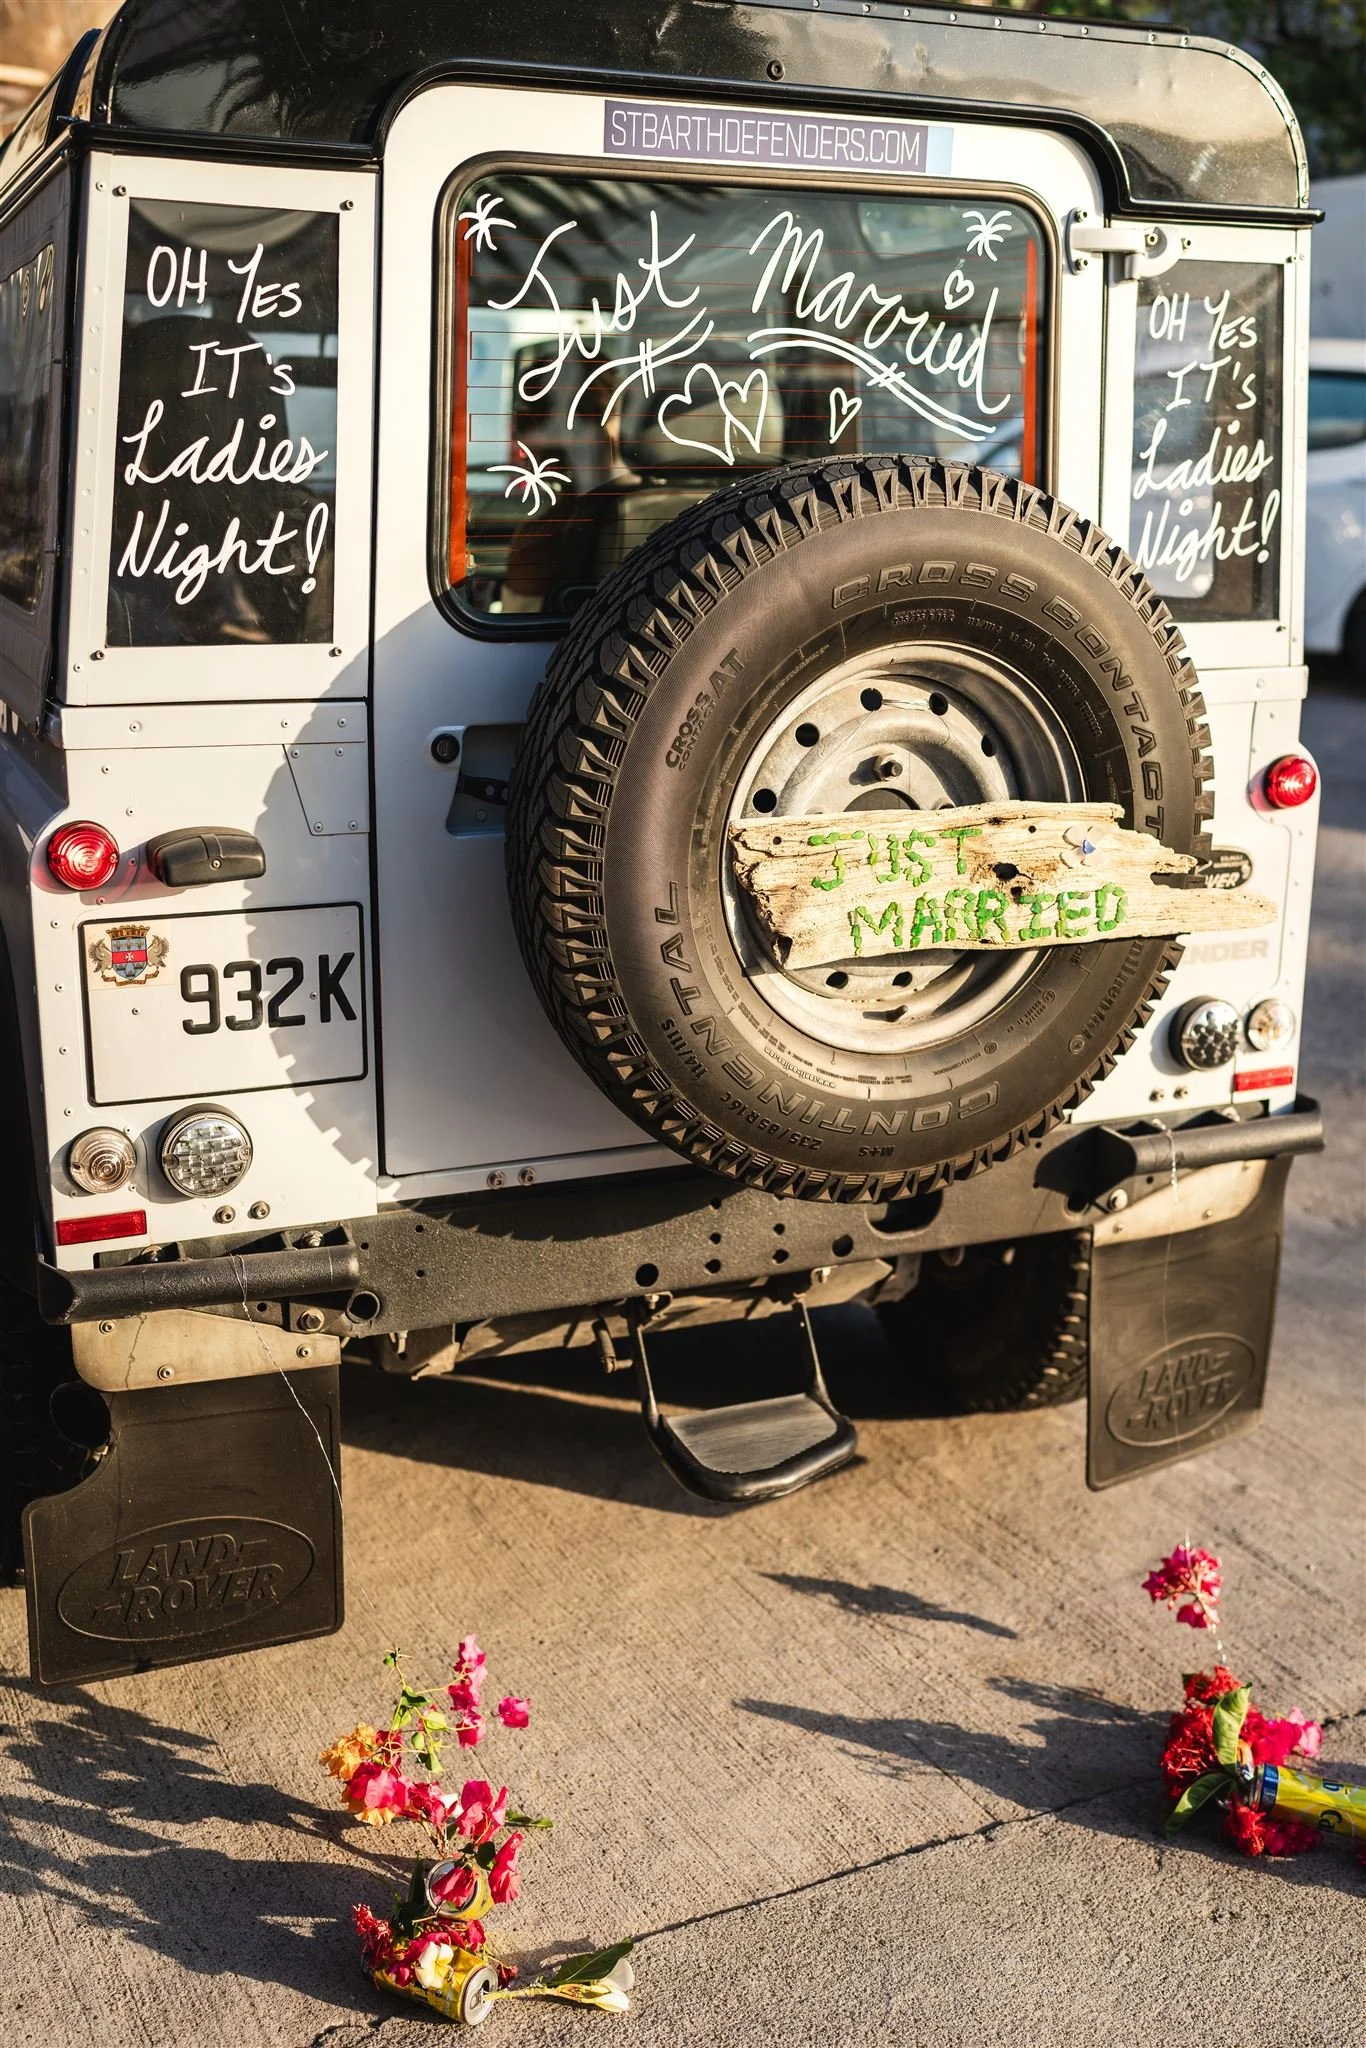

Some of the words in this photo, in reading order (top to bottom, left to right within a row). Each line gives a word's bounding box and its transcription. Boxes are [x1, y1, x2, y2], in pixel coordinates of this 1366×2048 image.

[610, 109, 922, 167] STBARTHDEFENDERS.COM
[146, 245, 208, 308] OH
[487, 210, 699, 401] Just
[748, 210, 1011, 415] Married
[1149, 291, 1190, 342] OH
[122, 399, 329, 486] Ladies
[1133, 418, 1274, 500] Ladies
[117, 499, 330, 605] Night!
[1134, 488, 1281, 582] Night!
[709, 648, 745, 699] AT
[832, 561, 1038, 609] CROSS
[1041, 595, 1166, 839] CONTACT
[665, 691, 711, 768] CROSS
[807, 828, 983, 891] JUST
[848, 881, 1129, 957] MARRIED
[654, 880, 1000, 1137] CONTINENTAL
[108, 1533, 236, 1590] LAND
[121, 1564, 284, 1625] ROVER
